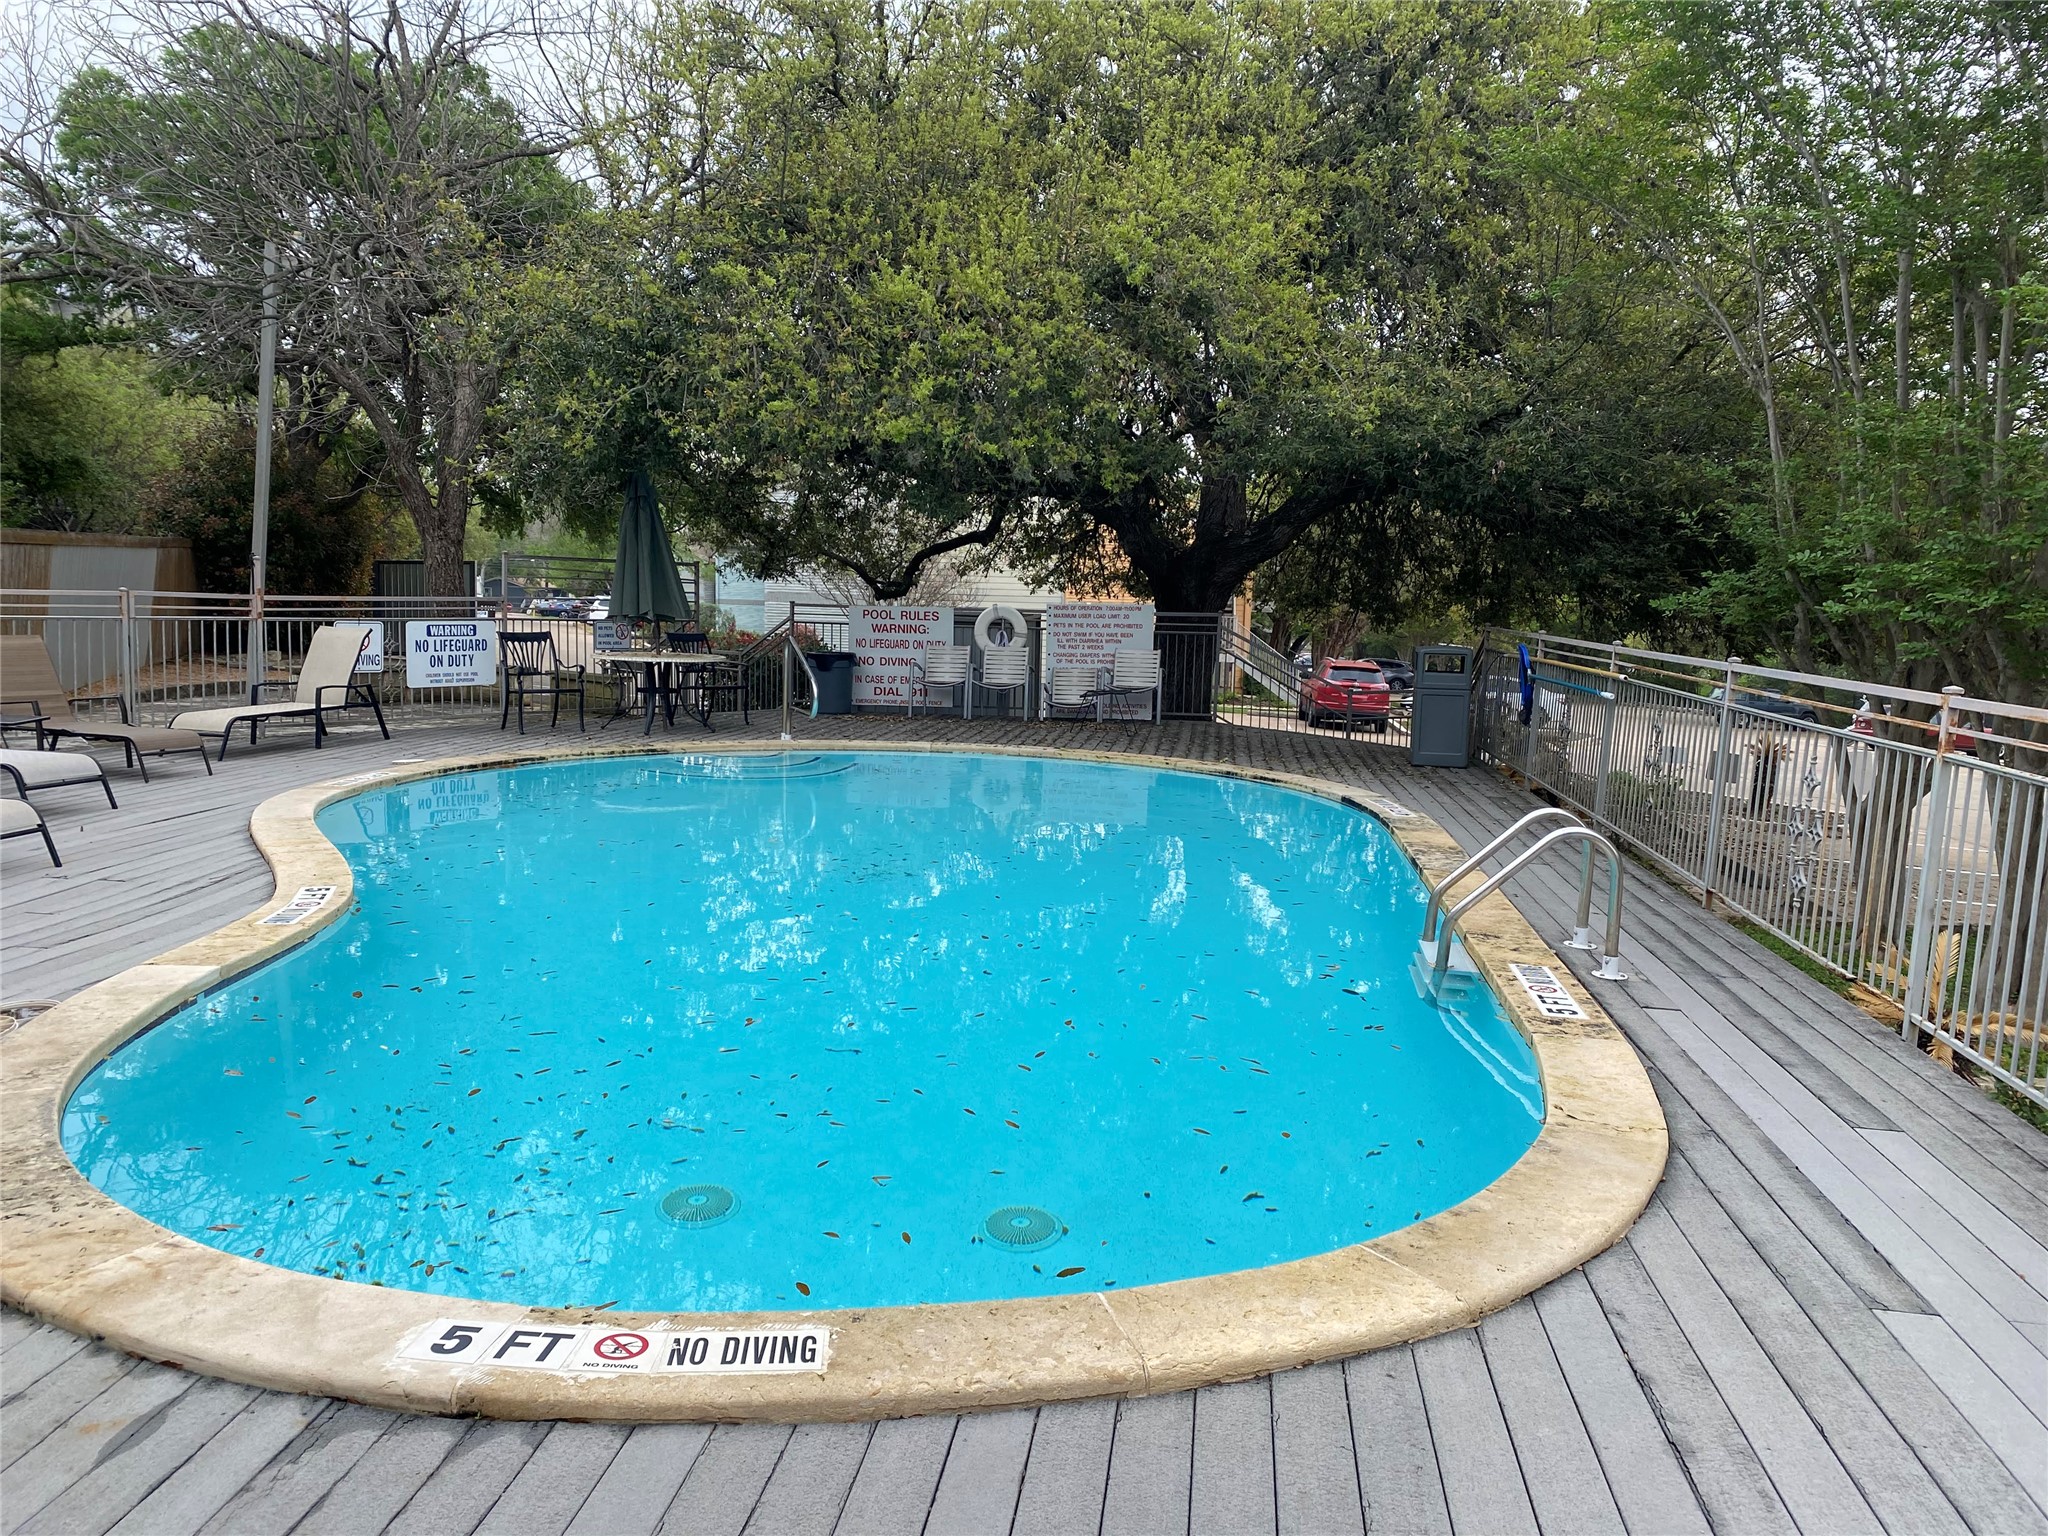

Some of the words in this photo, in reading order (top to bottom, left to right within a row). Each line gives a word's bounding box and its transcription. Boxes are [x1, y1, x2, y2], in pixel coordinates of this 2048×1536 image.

[863, 609, 895, 620] POOL
[900, 610, 940, 621] RULES
[430, 625, 474, 636] WARNING
[871, 623, 930, 635] WARNING:
[415, 639, 429, 653] NO
[433, 638, 488, 653] LIFEGUARD
[856, 638, 867, 649] NO
[869, 638, 910, 650] LIFEGUARD
[912, 639, 924, 650] ON
[429, 654, 443, 668] ON
[448, 653, 475, 668] DUTY
[858, 656, 875, 666] NO
[854, 674, 863, 684] IN
[865, 674, 885, 684] CASE
[887, 675, 898, 685] OF
[873, 686, 903, 697] DIAL
[911, 687, 928, 698] 911
[1536, 994, 1573, 1006] FT
[430, 1324, 484, 1355] 5
[492, 1330, 576, 1362] FT
[666, 1336, 709, 1367] NO
[720, 1335, 818, 1366] DIVING
[602, 1362, 639, 1370] DIVING
